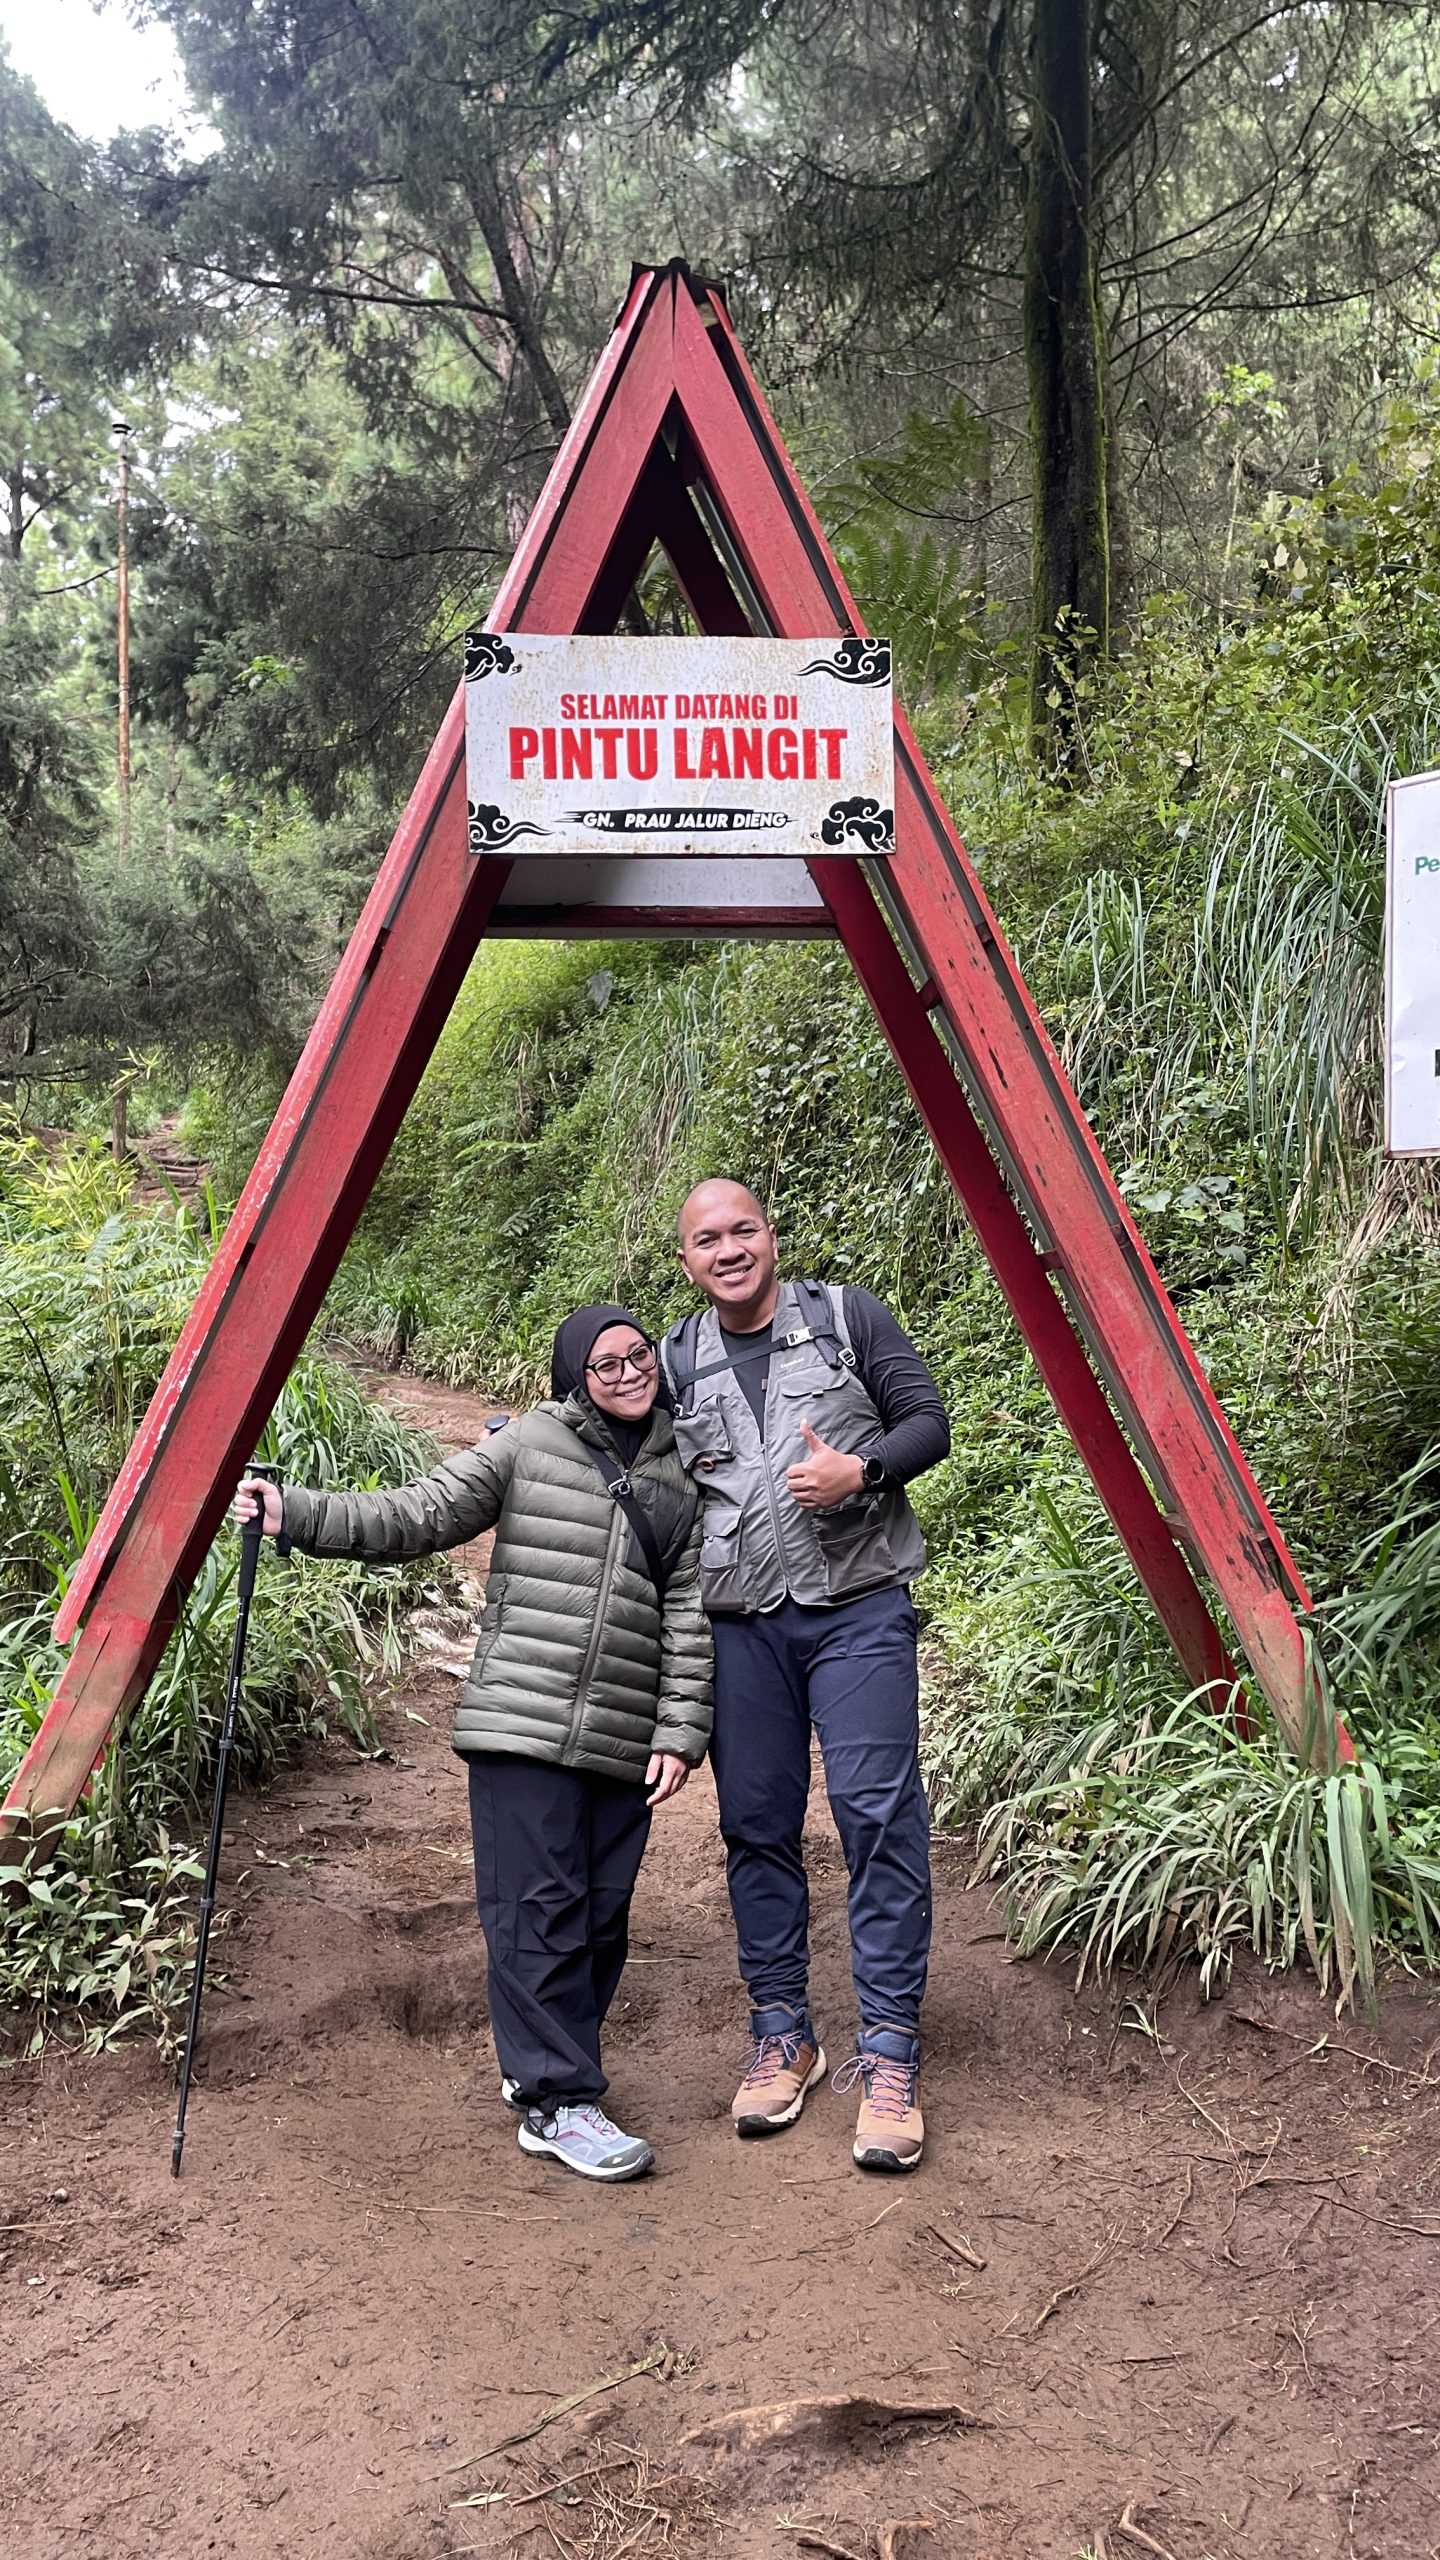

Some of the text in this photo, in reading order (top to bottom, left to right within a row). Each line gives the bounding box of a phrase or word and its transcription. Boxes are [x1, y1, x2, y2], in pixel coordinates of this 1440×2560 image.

[560, 693, 798, 720] SELAMAT DATANG DI
[509, 727, 848, 780] PINTU LANGIT
[583, 812, 788, 828] GN. PRAU JALUR DIENG
